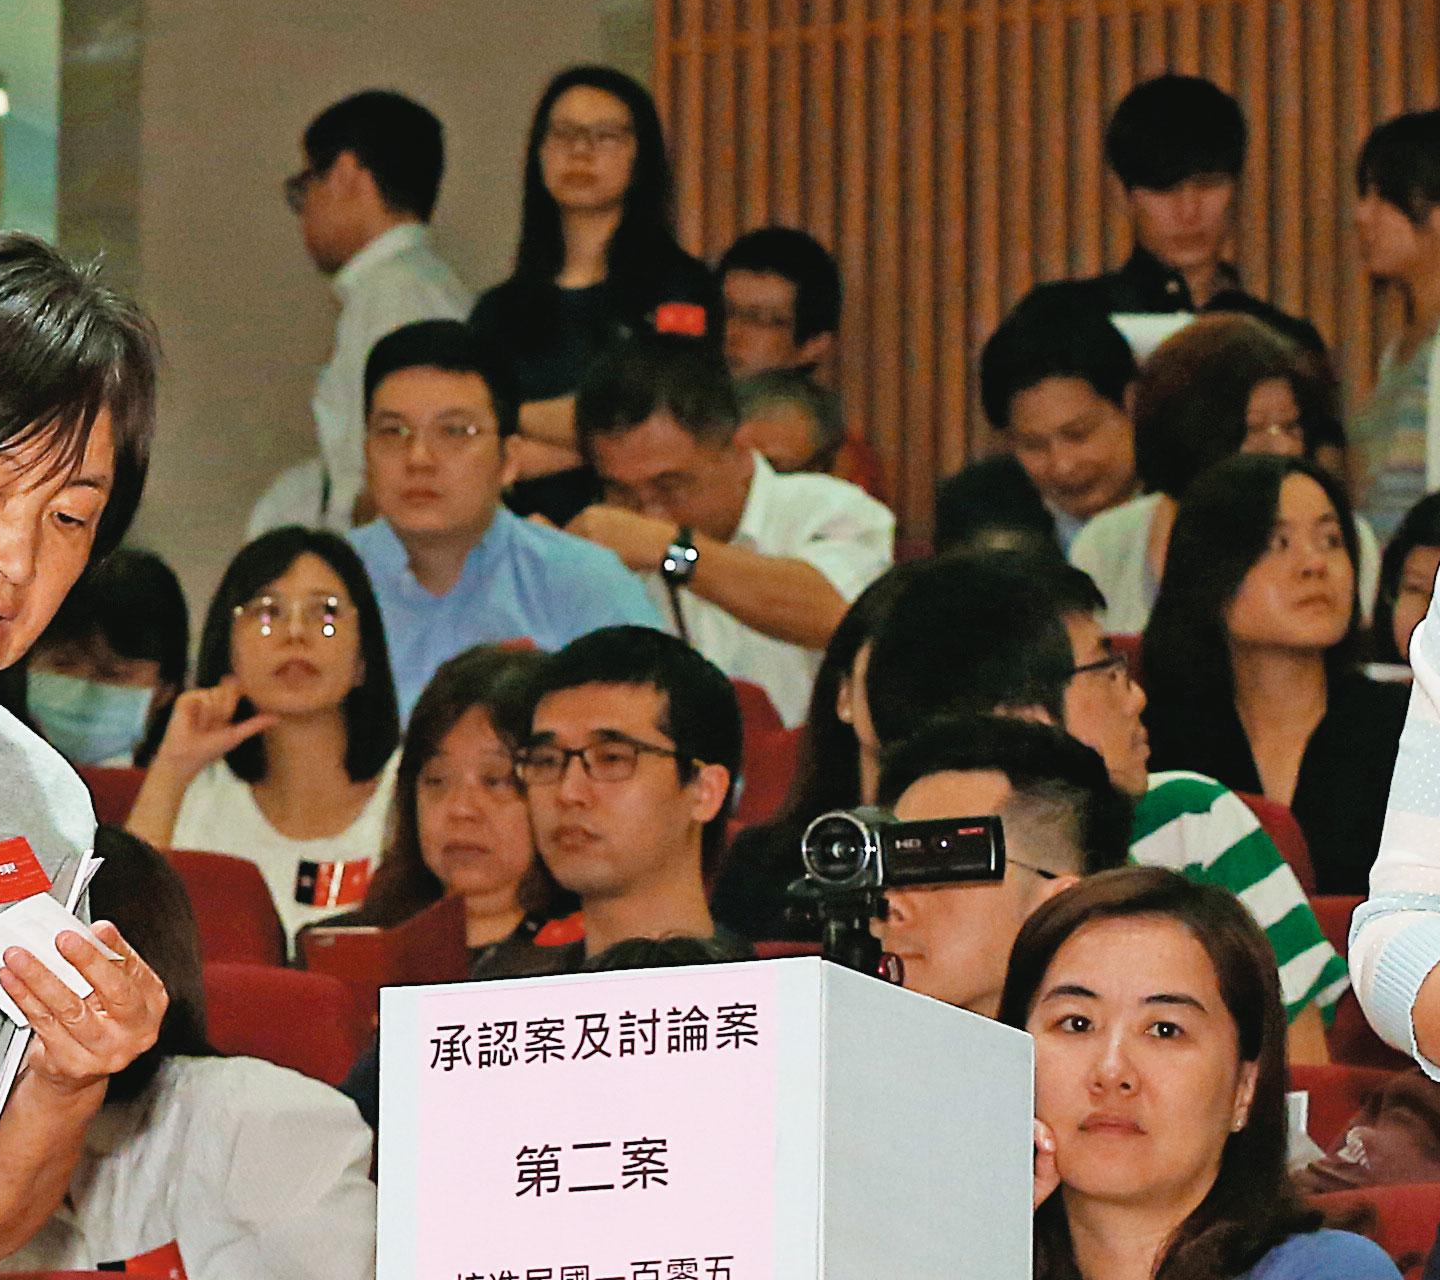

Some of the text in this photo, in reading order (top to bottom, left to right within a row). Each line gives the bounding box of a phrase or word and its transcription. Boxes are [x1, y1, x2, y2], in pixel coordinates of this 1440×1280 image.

[429, 1002, 760, 1073] 承認案及討論案
[514, 1136, 670, 1198] 第二案
